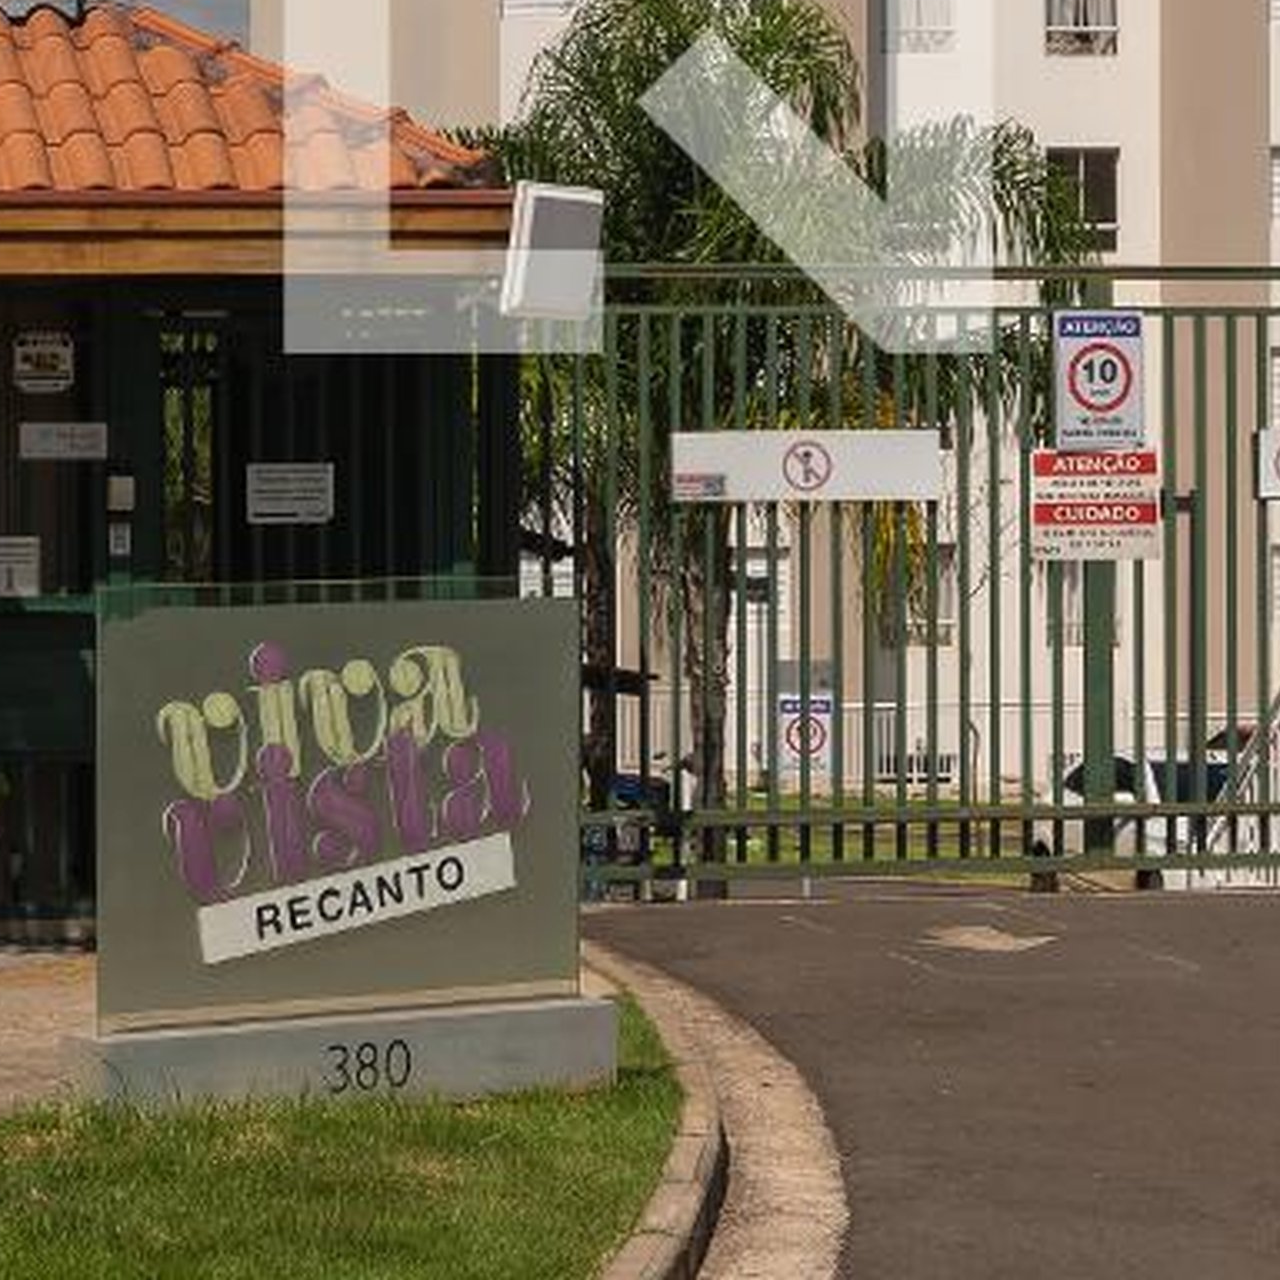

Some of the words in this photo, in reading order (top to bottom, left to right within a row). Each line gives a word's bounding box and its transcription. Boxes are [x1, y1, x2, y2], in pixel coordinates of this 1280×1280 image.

[1082, 358, 1118, 384] 10
[1052, 455, 1142, 474] ATENÇÃO
[1052, 505, 1142, 521] CUIDADO
[254, 855, 466, 940] RECANTO
[323, 1038, 413, 1095] 380
